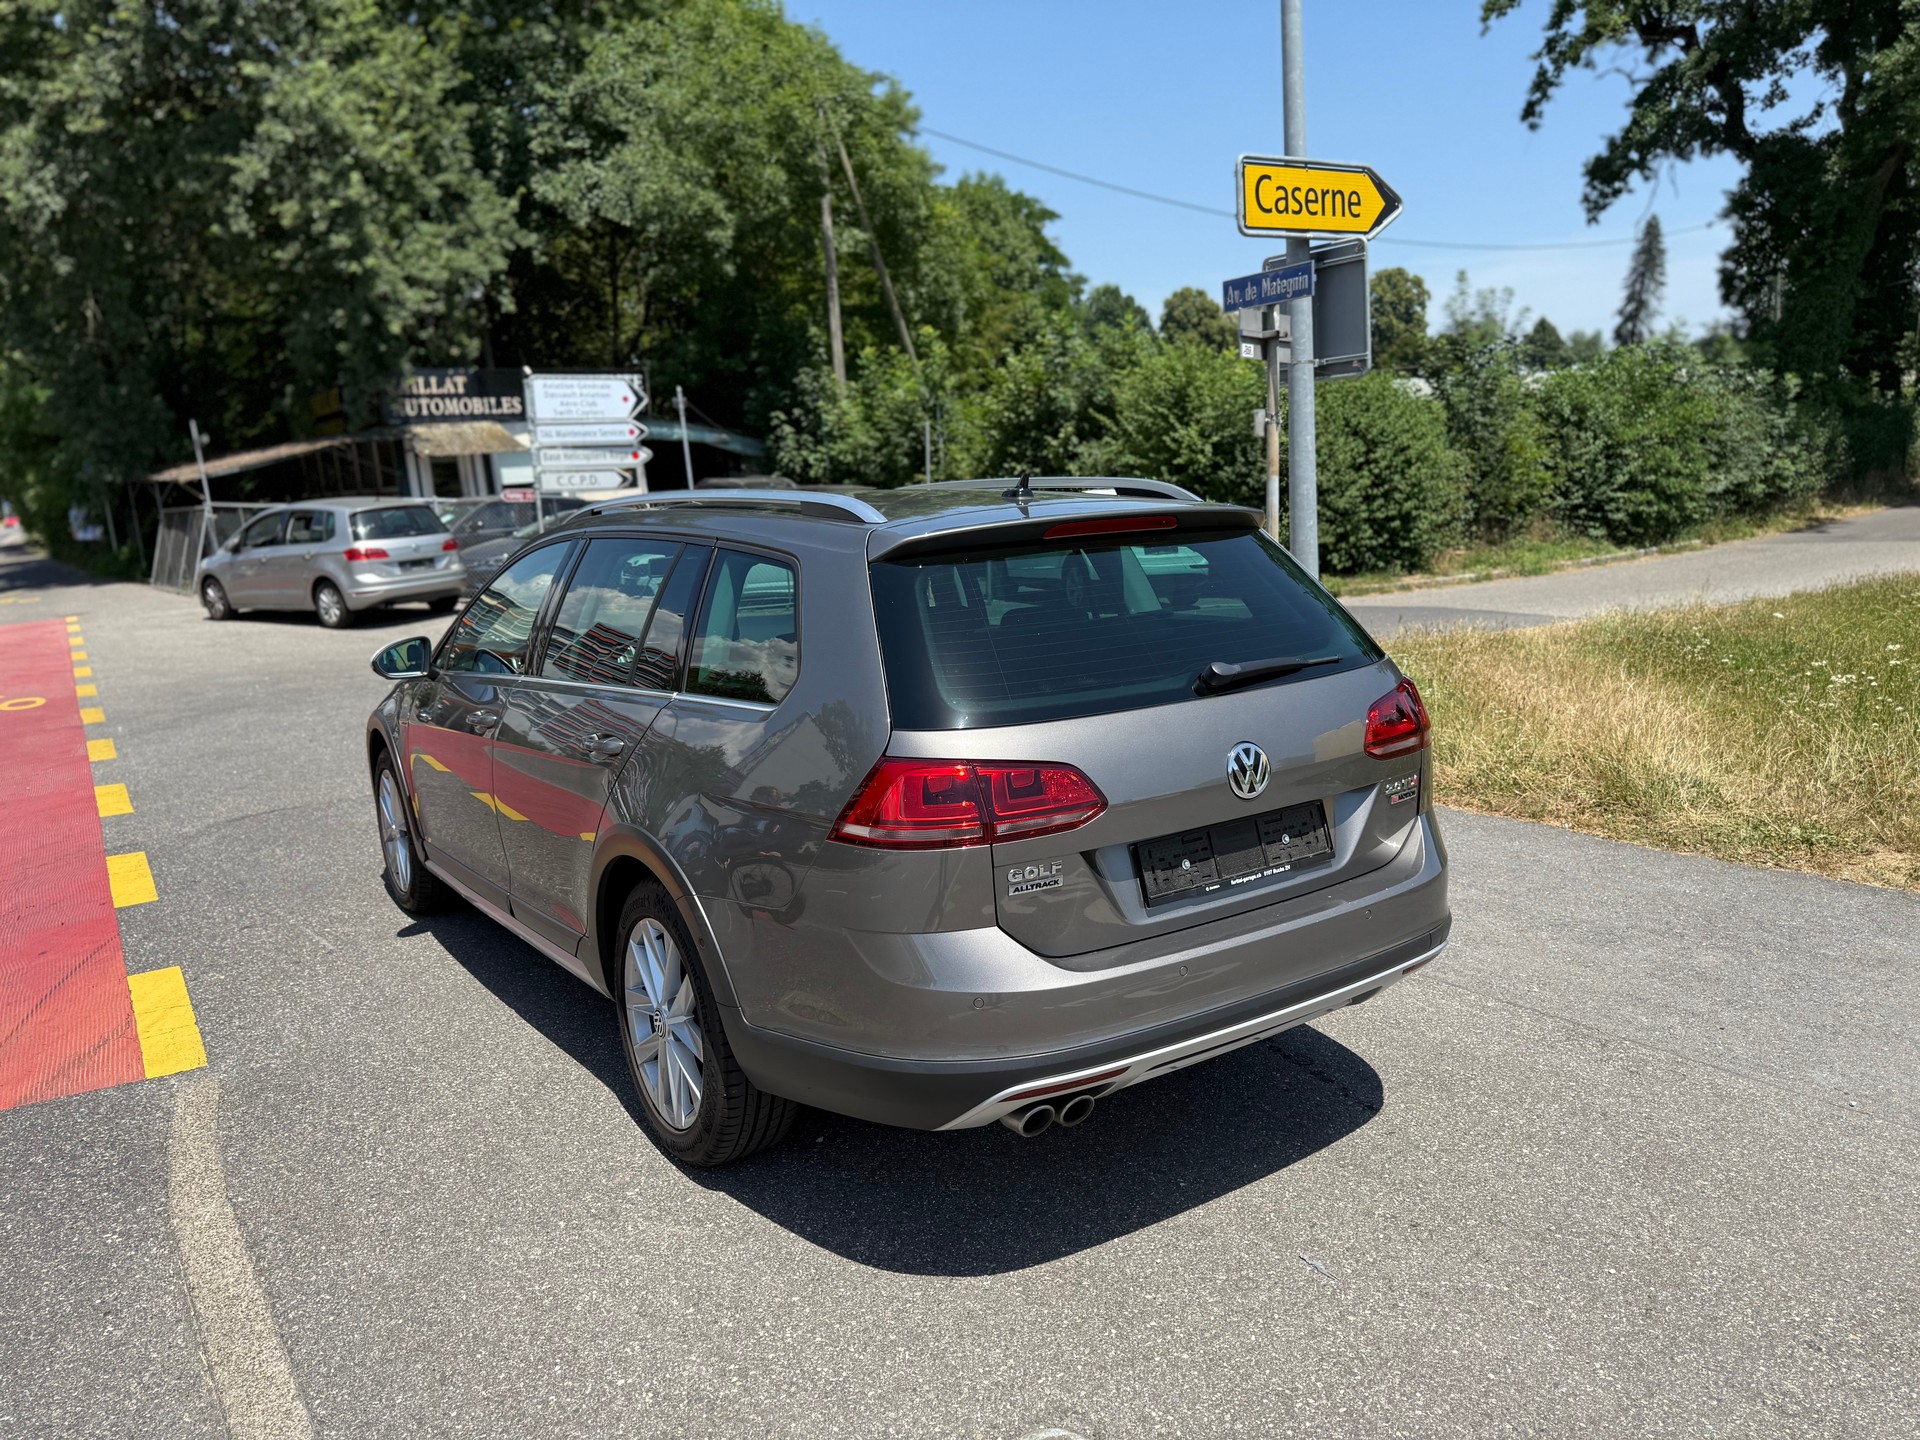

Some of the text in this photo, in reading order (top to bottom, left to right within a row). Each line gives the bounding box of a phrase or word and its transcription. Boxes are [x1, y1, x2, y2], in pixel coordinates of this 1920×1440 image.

[1255, 174, 1361, 218] Caserne
[1227, 272, 1309, 305] Av. de Mategnin
[1007, 860, 1063, 882] GOLF
[1012, 878, 1060, 894] ALLTRACK
